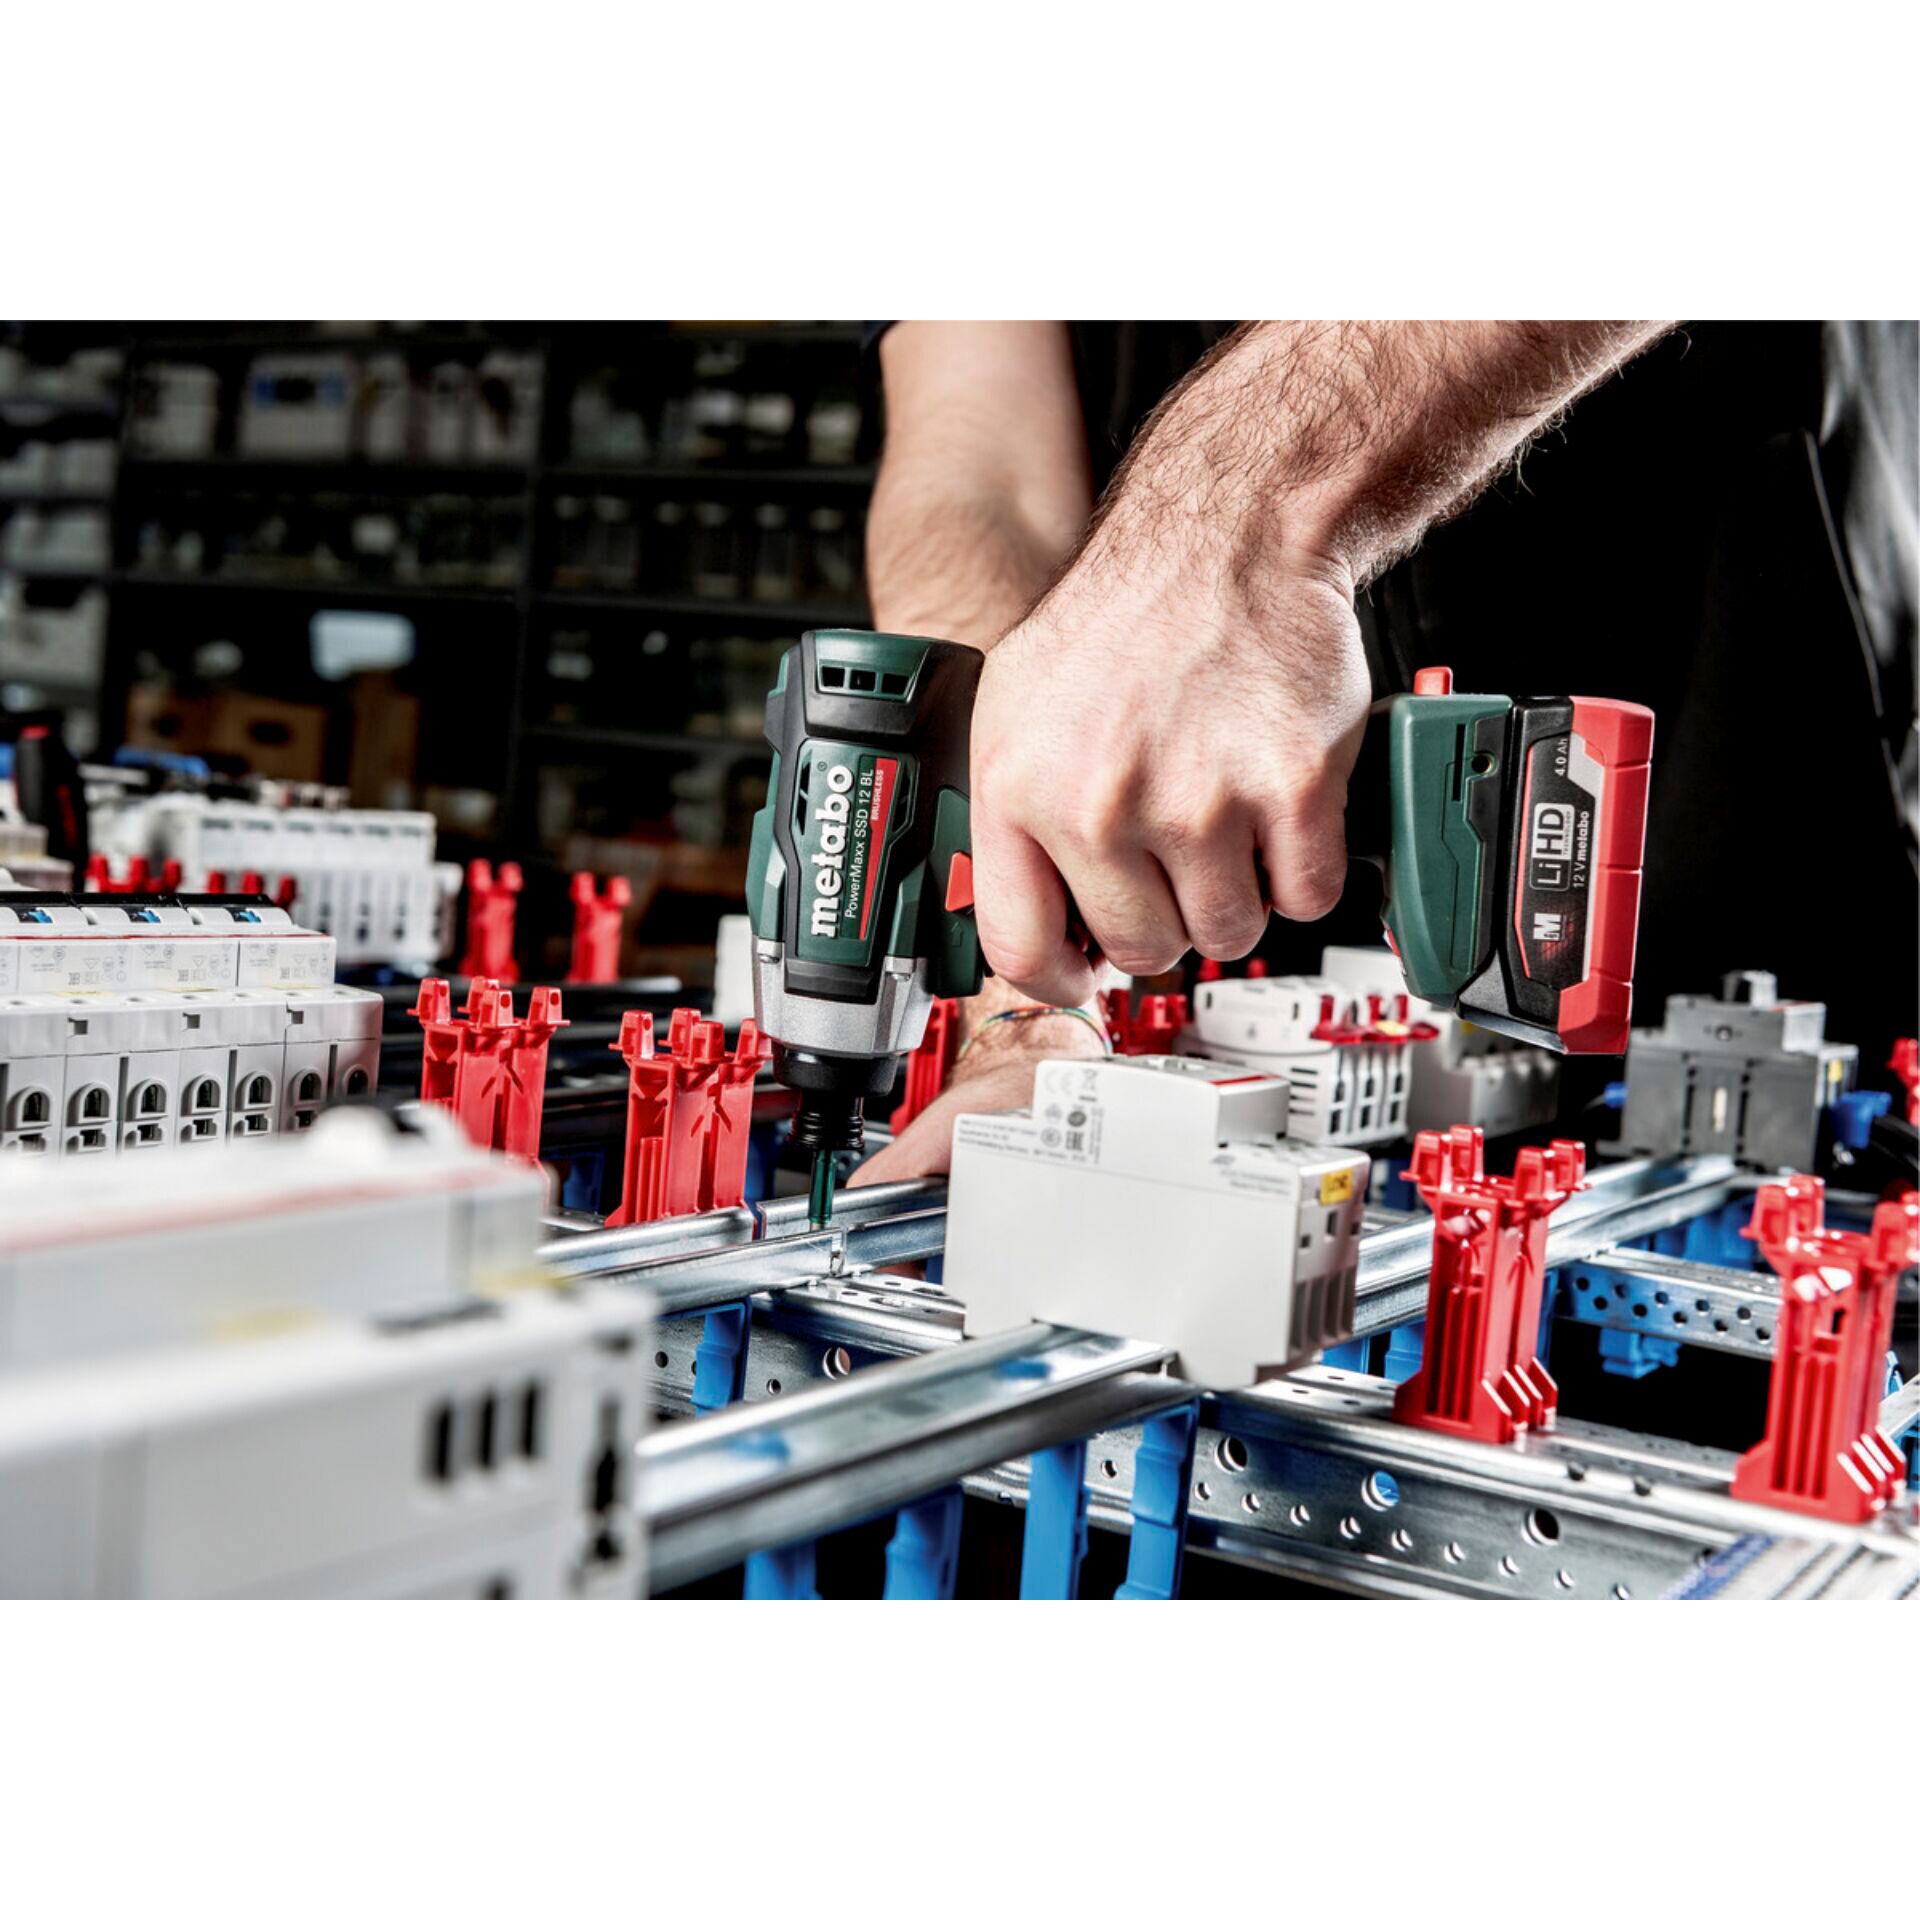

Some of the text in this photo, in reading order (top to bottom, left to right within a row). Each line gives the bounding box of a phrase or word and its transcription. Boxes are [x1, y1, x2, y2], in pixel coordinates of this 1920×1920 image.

[871, 769, 885, 822] BRUSHLESS
[1555, 738, 1568, 777] 4.0 Ah
[811, 765, 853, 938] metabo
[845, 769, 874, 919] PowerMaxx SSD 12 BL
[1573, 810, 1590, 889] 12 V metabo
